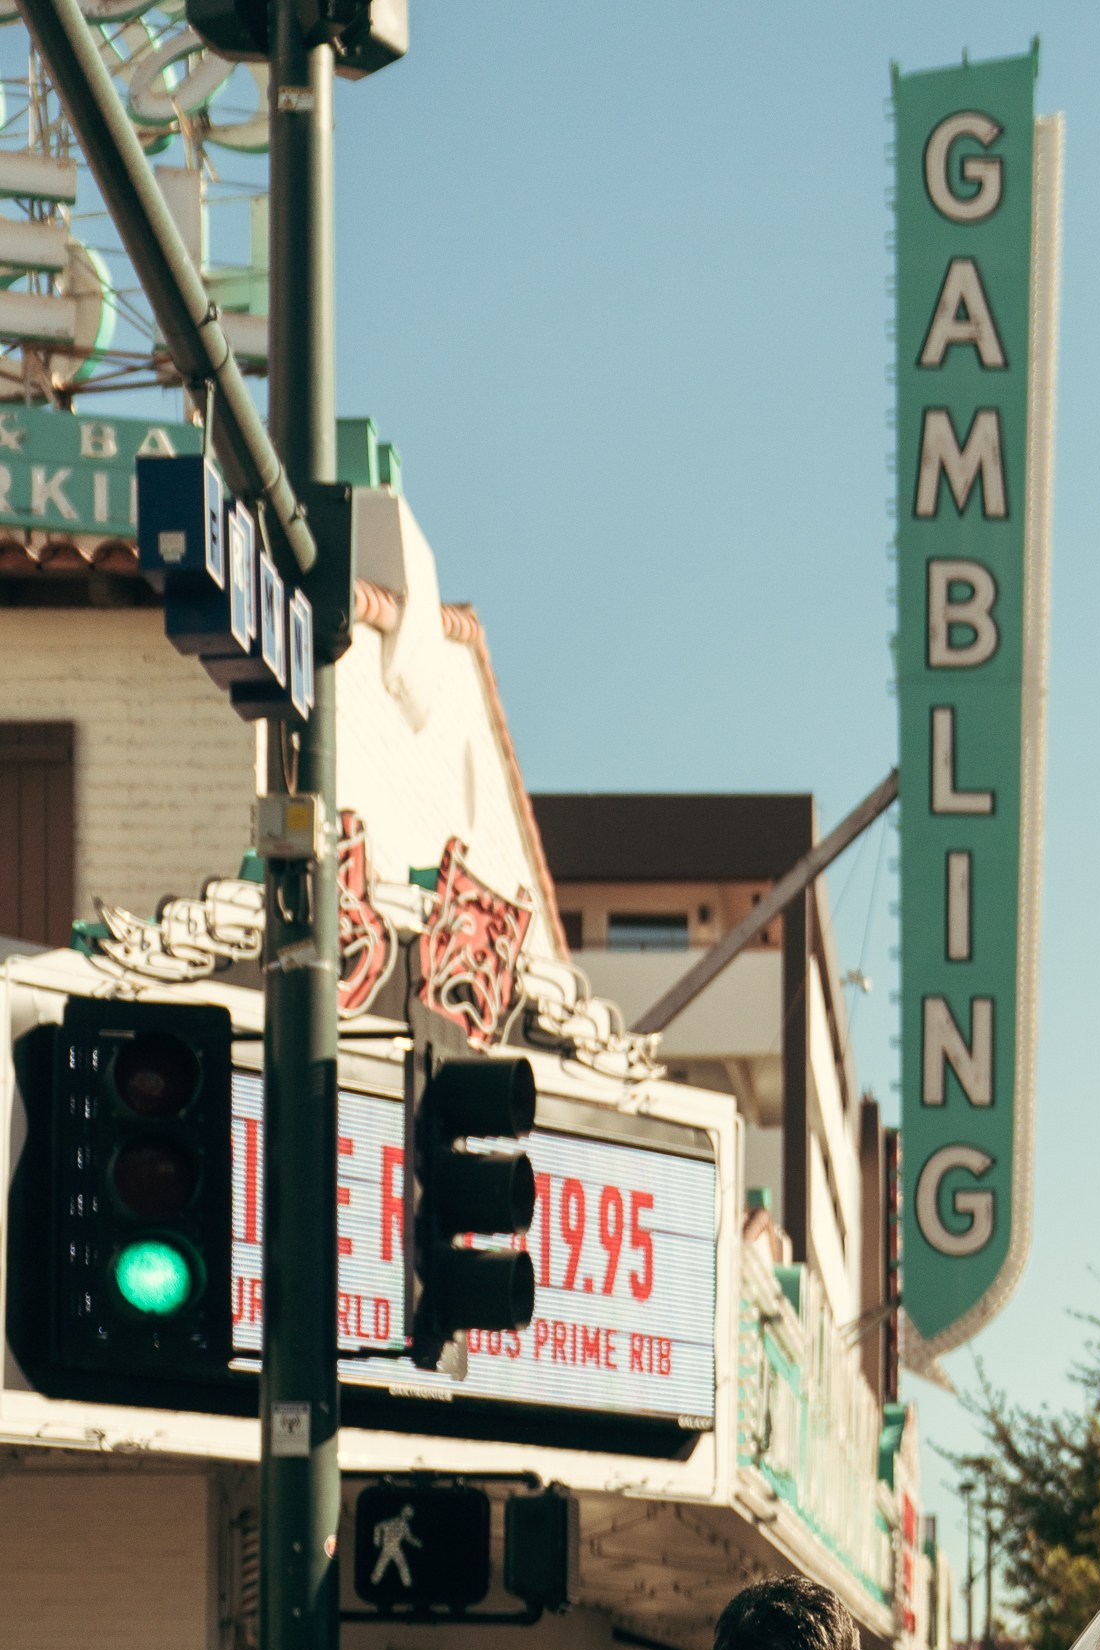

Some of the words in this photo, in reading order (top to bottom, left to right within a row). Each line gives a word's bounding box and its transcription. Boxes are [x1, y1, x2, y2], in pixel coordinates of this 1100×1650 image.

[912, 109, 1010, 1257] GAMBLING
[534, 1318, 618, 1371] PRIME
[629, 1332, 671, 1376] RIB
